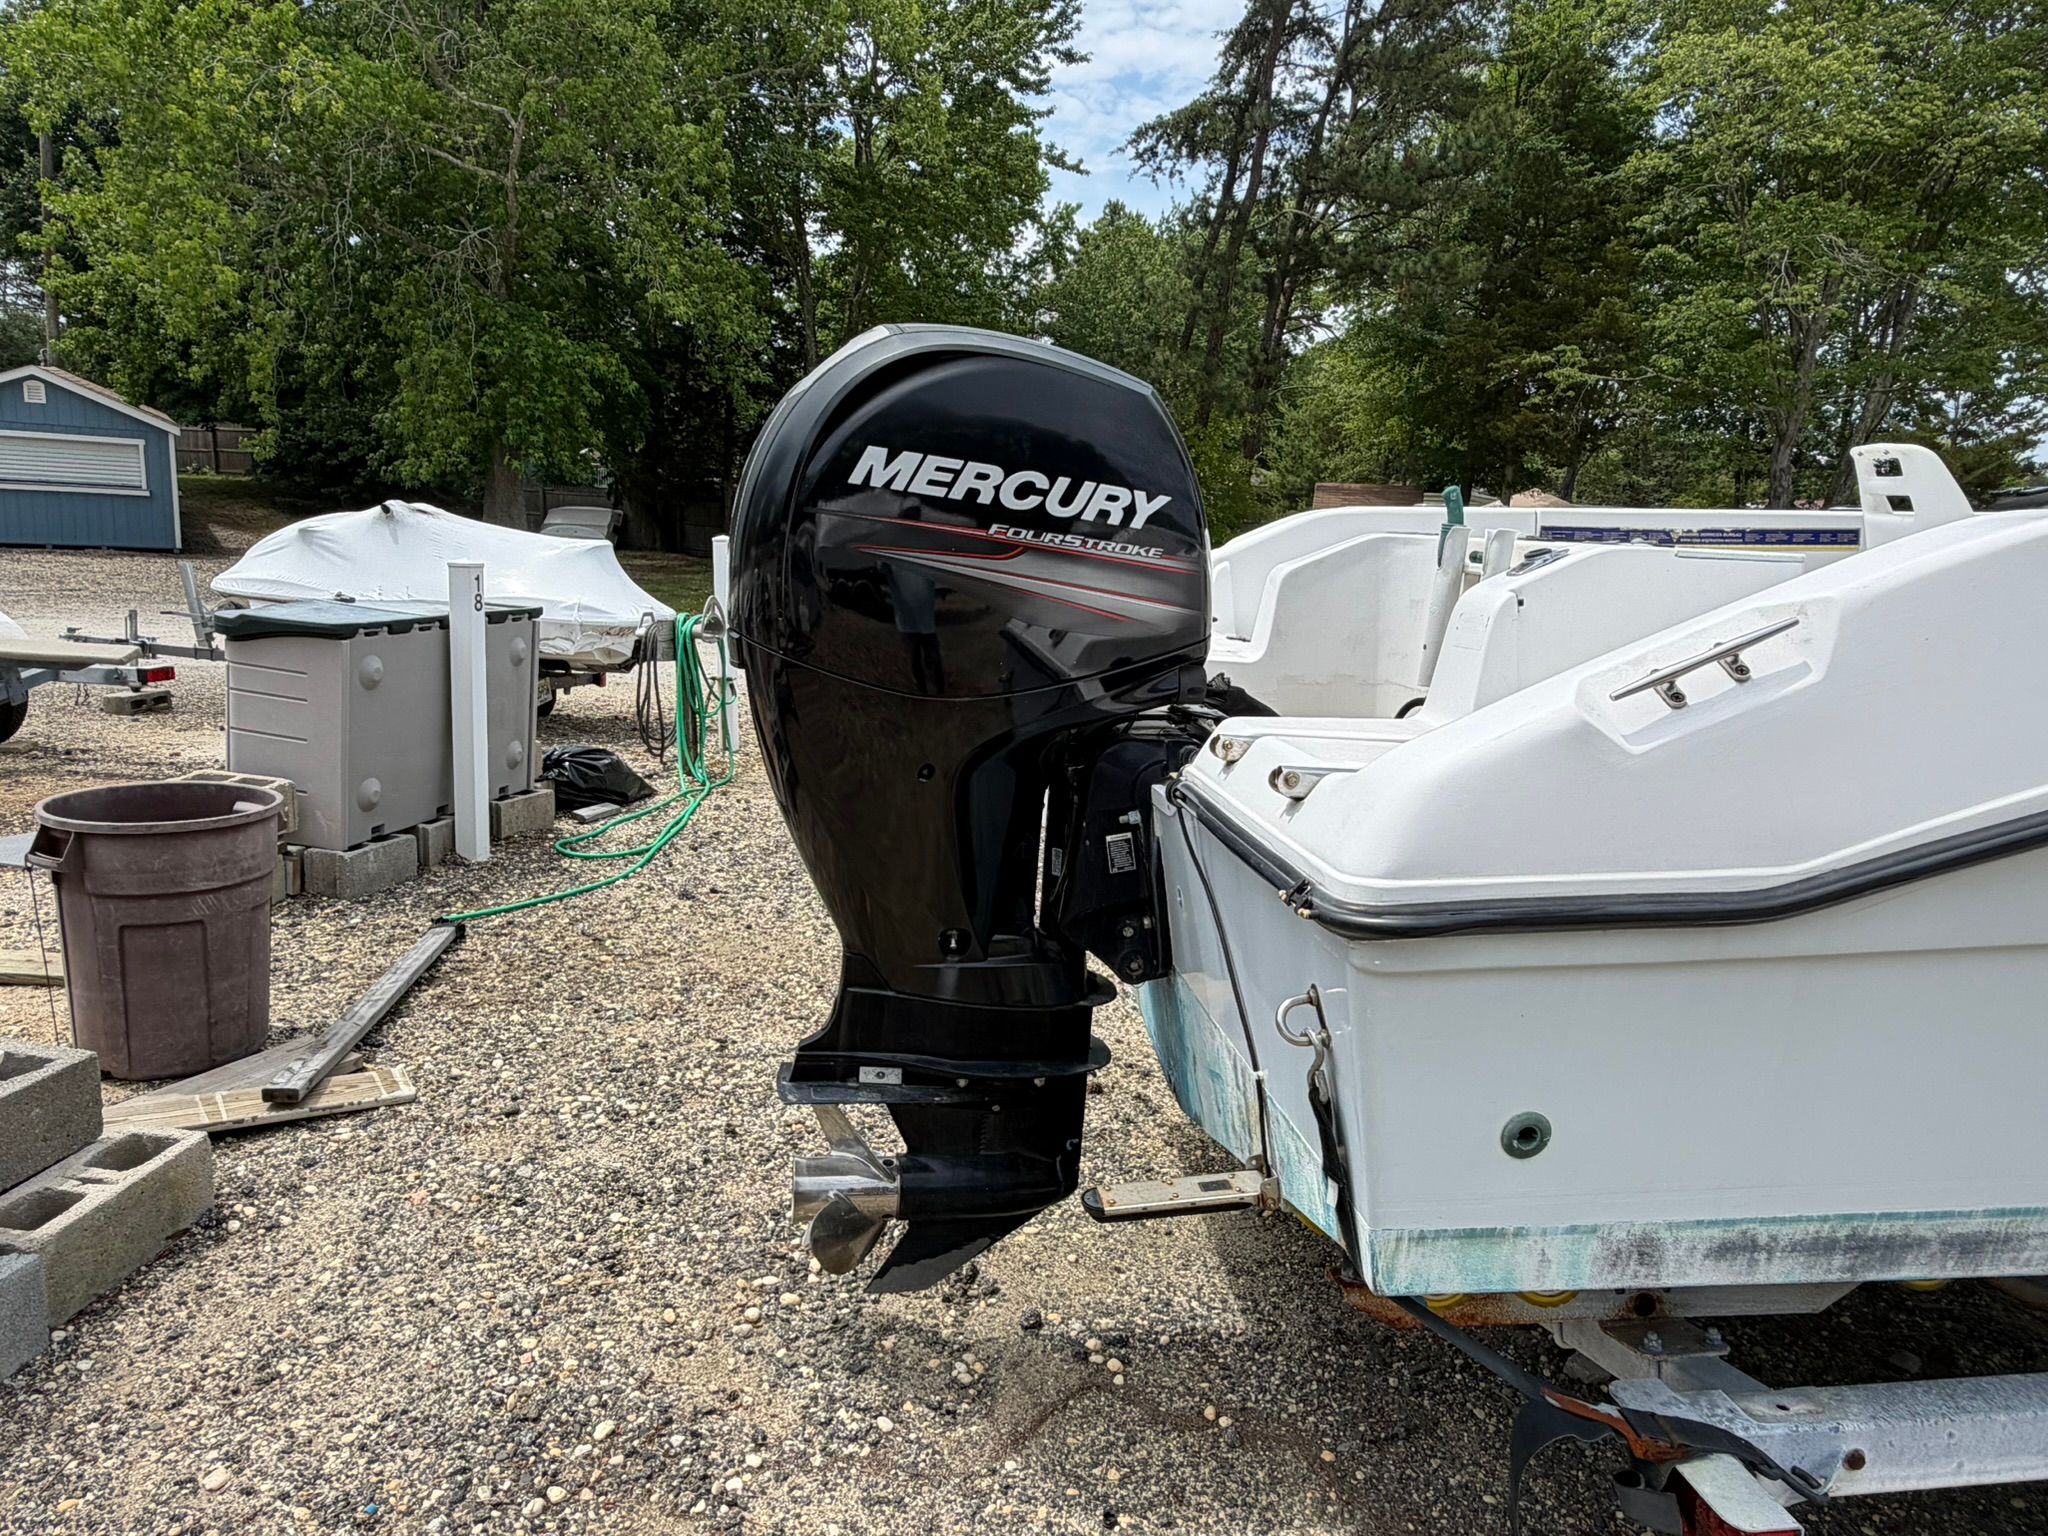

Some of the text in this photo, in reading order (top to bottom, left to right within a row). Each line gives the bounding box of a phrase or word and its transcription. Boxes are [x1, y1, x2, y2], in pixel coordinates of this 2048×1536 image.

[848, 445, 1172, 529] MERCURY
[987, 523, 1164, 558] FOURSTROKE
[474, 574, 482, 611] 18
